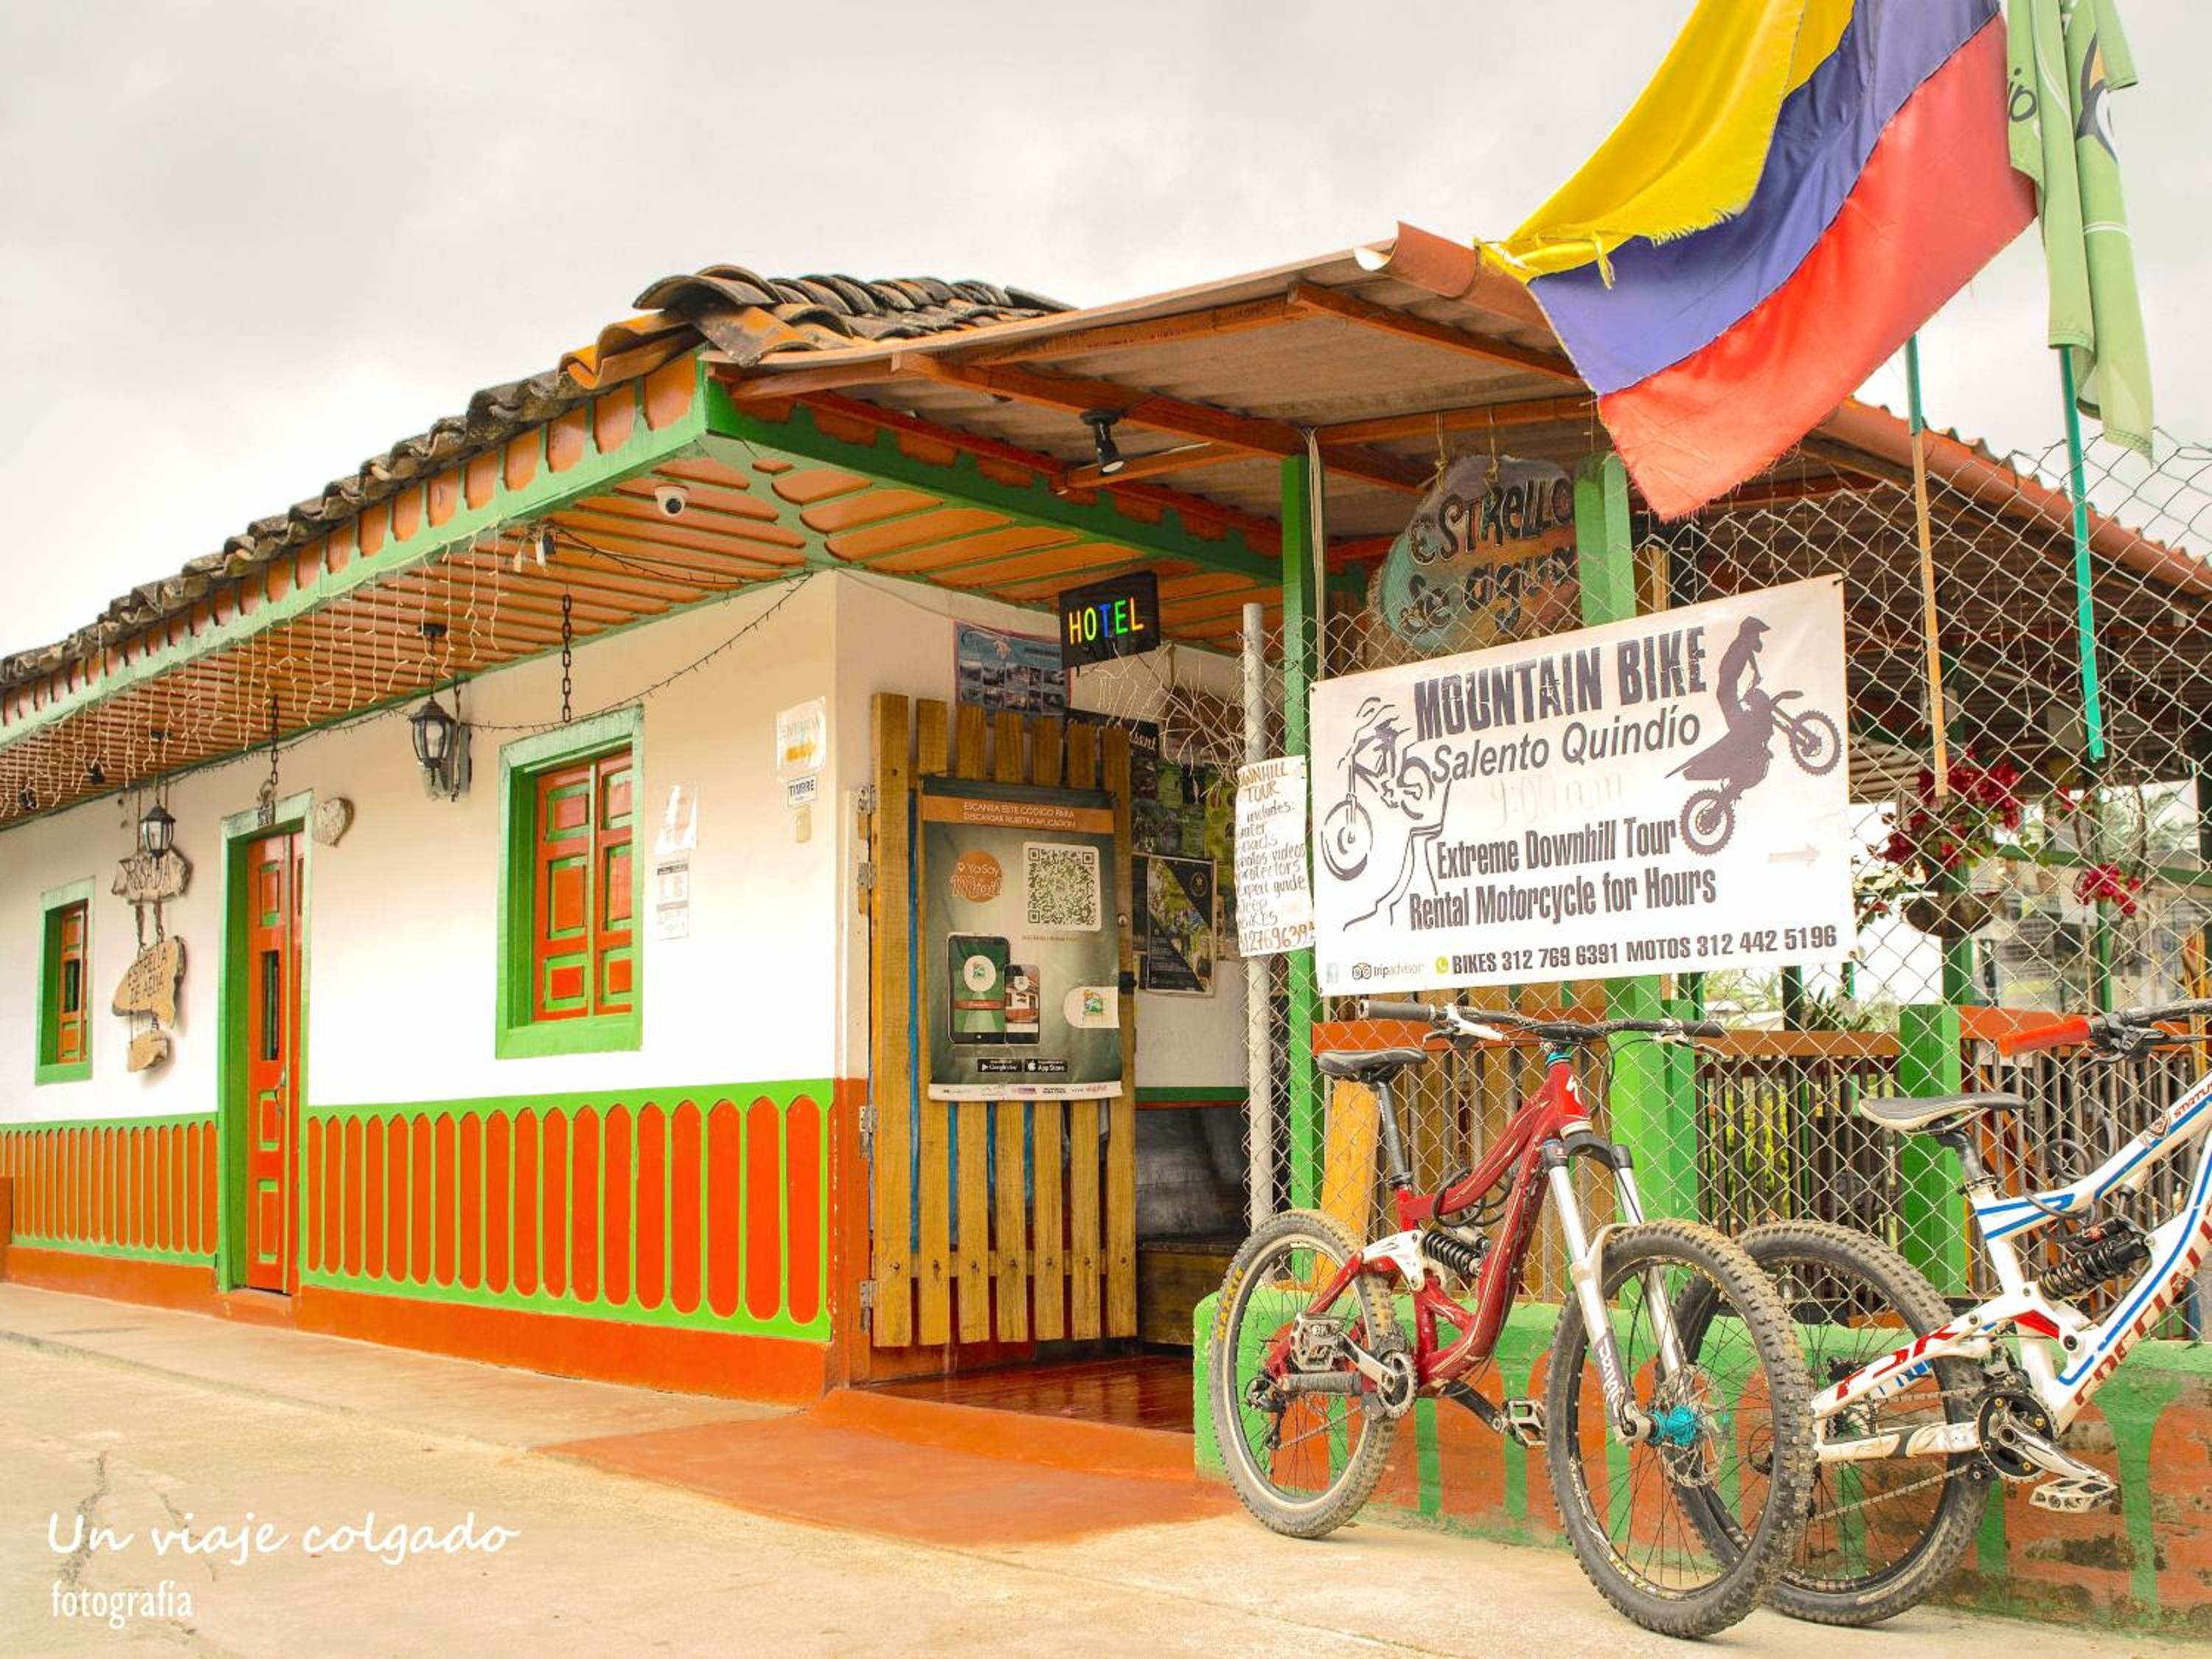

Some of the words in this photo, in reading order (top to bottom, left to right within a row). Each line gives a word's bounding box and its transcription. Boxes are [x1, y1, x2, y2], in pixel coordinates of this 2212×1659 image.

[1069, 597, 1144, 645] HOTEL
[1414, 647, 1602, 742] MOUNTAIN
[1617, 626, 1707, 706] BIKE
[1431, 732, 1549, 783] Salento
[1562, 704, 1701, 765] Quindío
[1436, 839, 1520, 880] Extreme
[1525, 819, 1617, 869] Downhill
[1624, 816, 1677, 858] Tour
[1409, 887, 1470, 931] Rental
[1475, 875, 1596, 925] Motorcycle
[1602, 872, 1638, 913] for
[1644, 867, 1717, 909] Hours
[1453, 952, 1498, 974] BIKES
[1502, 949, 1533, 971] 312
[1539, 946, 1571, 968] 769
[1576, 942, 1618, 965] 6391
[1626, 936, 1691, 961] MOTOS
[1697, 933, 1733, 957] 312
[1740, 930, 1778, 953] 442
[1784, 924, 1837, 950] 5196
